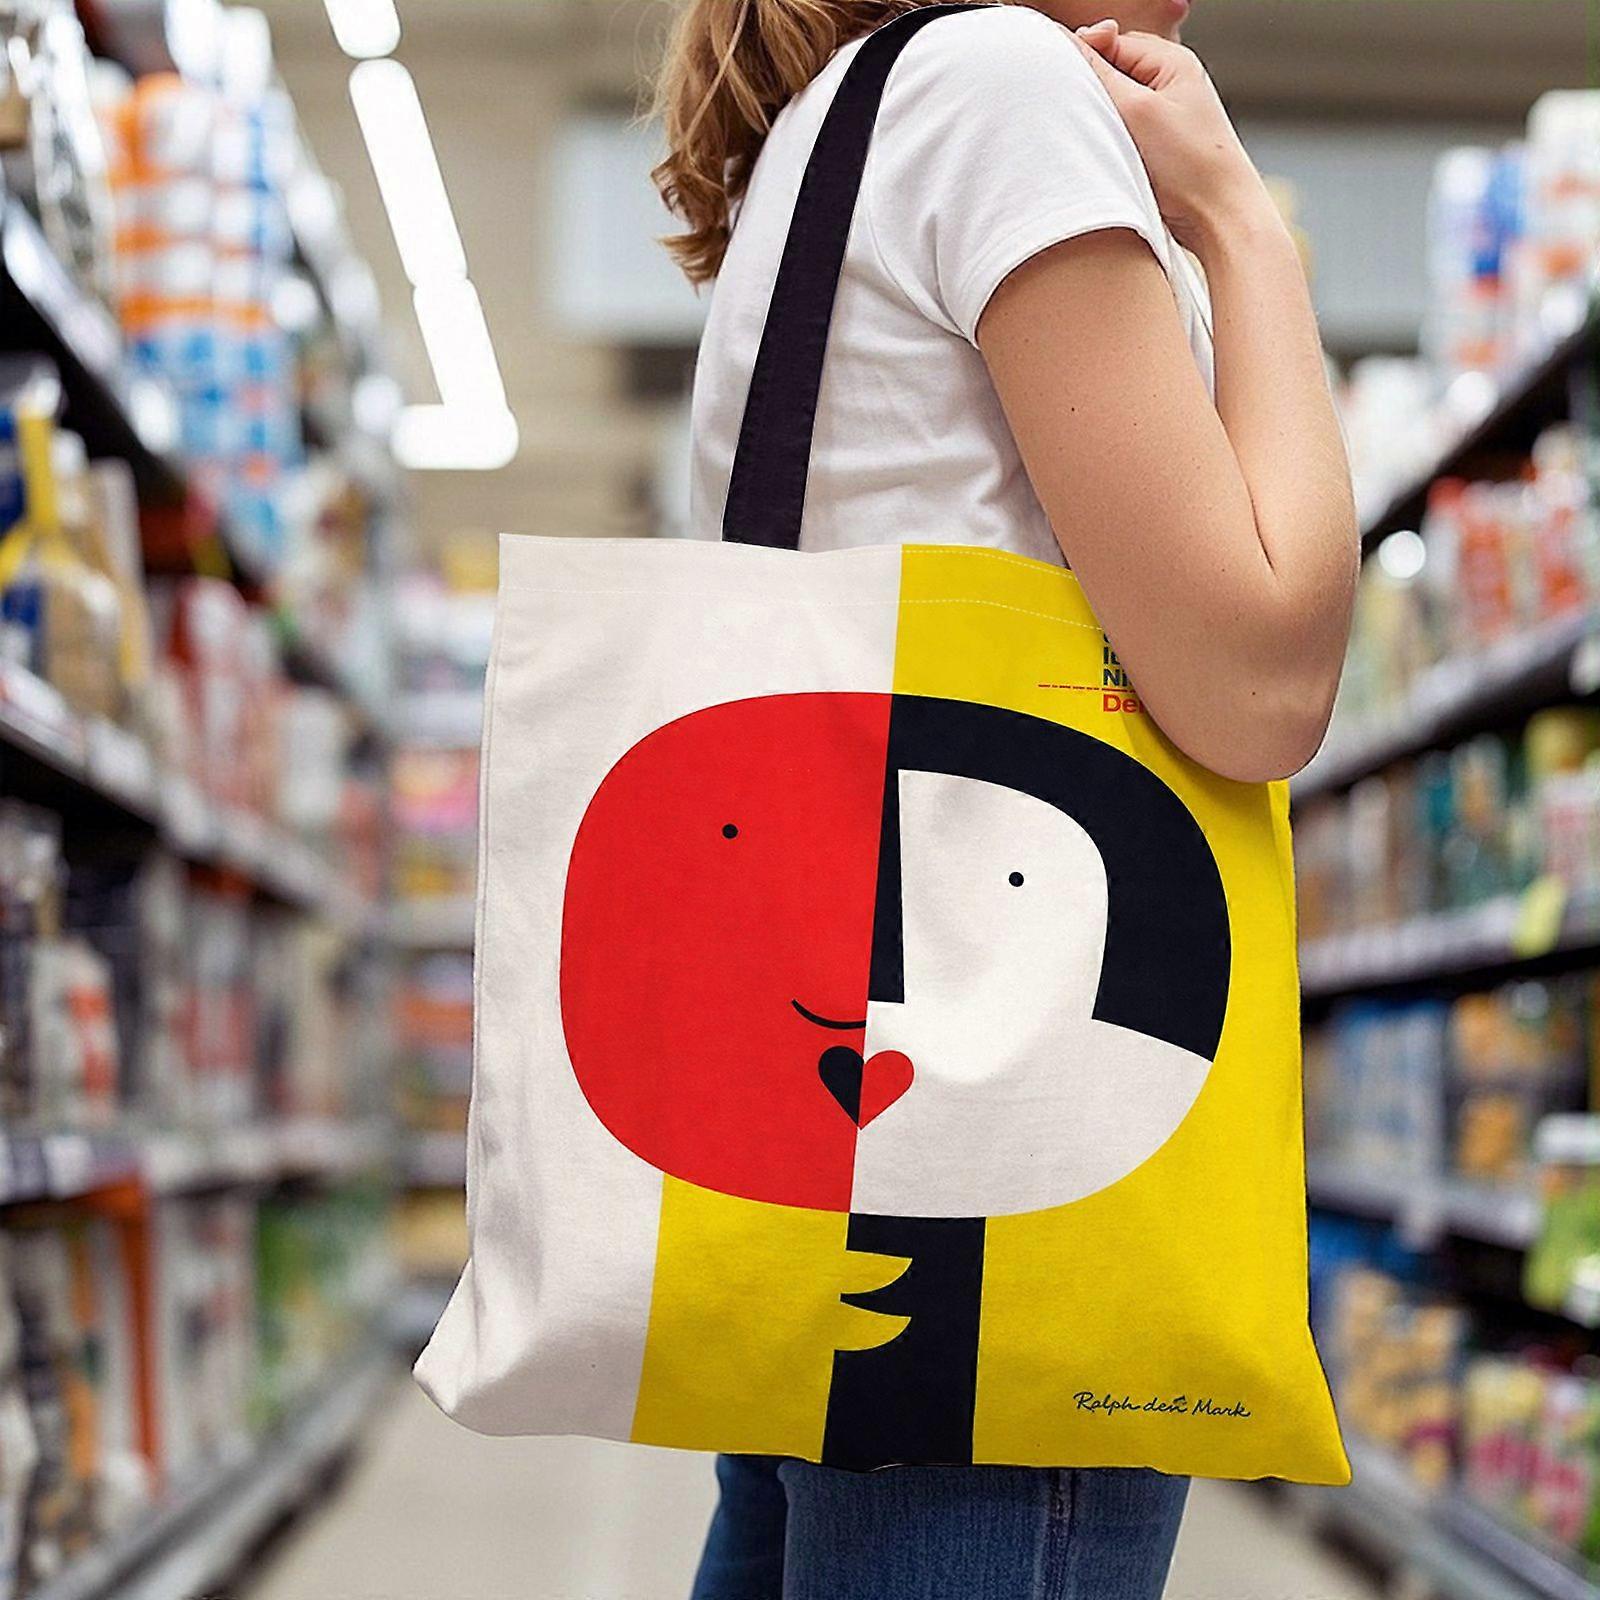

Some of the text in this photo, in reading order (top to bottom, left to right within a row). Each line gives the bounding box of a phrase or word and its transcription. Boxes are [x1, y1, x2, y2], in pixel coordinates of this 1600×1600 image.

[1103, 668, 1129, 687] Ni
[1073, 1391, 1140, 1416] Ralph
[1191, 1398, 1251, 1418] Mark
